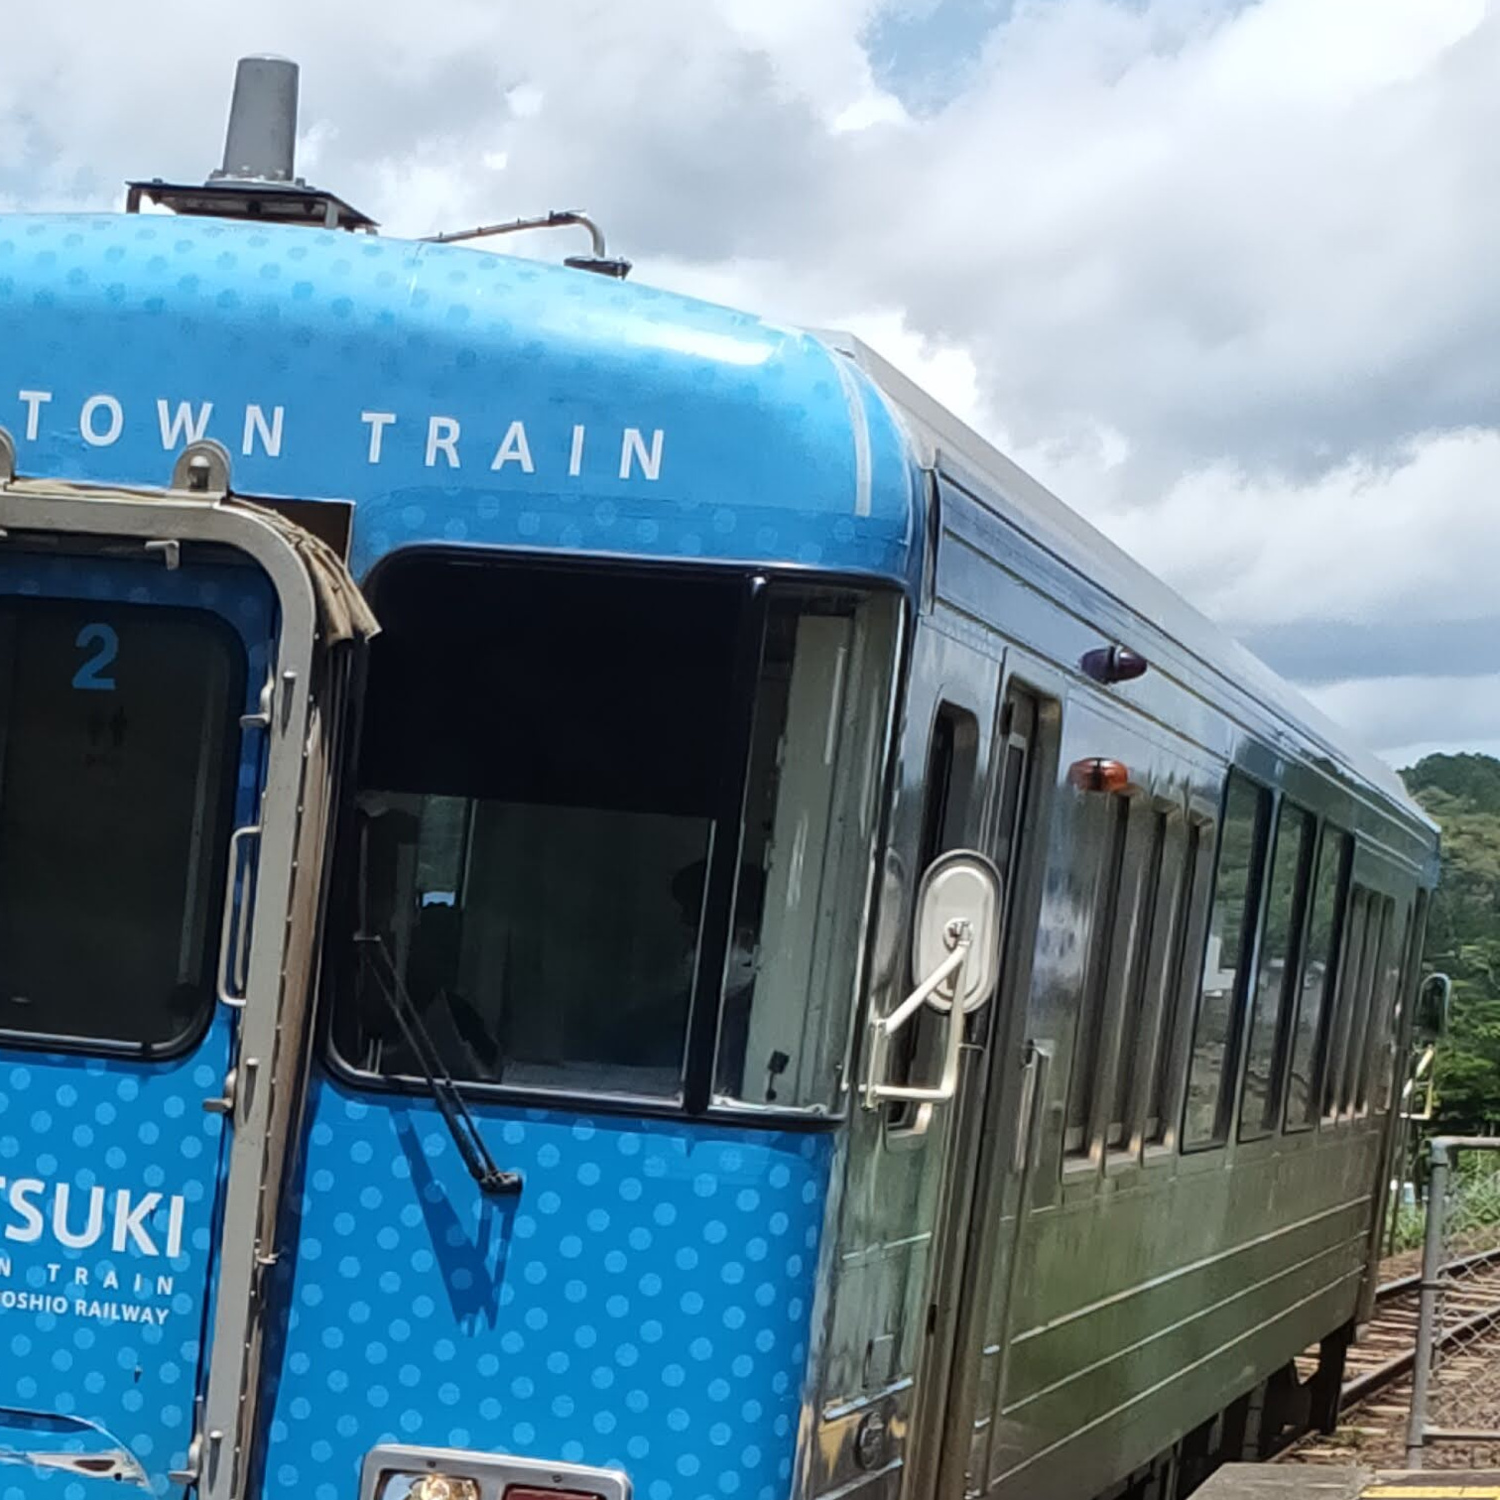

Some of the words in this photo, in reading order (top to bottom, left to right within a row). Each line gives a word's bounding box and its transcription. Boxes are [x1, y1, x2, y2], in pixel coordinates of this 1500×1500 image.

[19, 389, 285, 457] TOWN
[361, 412, 664, 481] TRAIN
[72, 623, 119, 690] 2
[48, 1264, 174, 1296] TRAIN
[75, 1299, 169, 1326] RAILWAY
